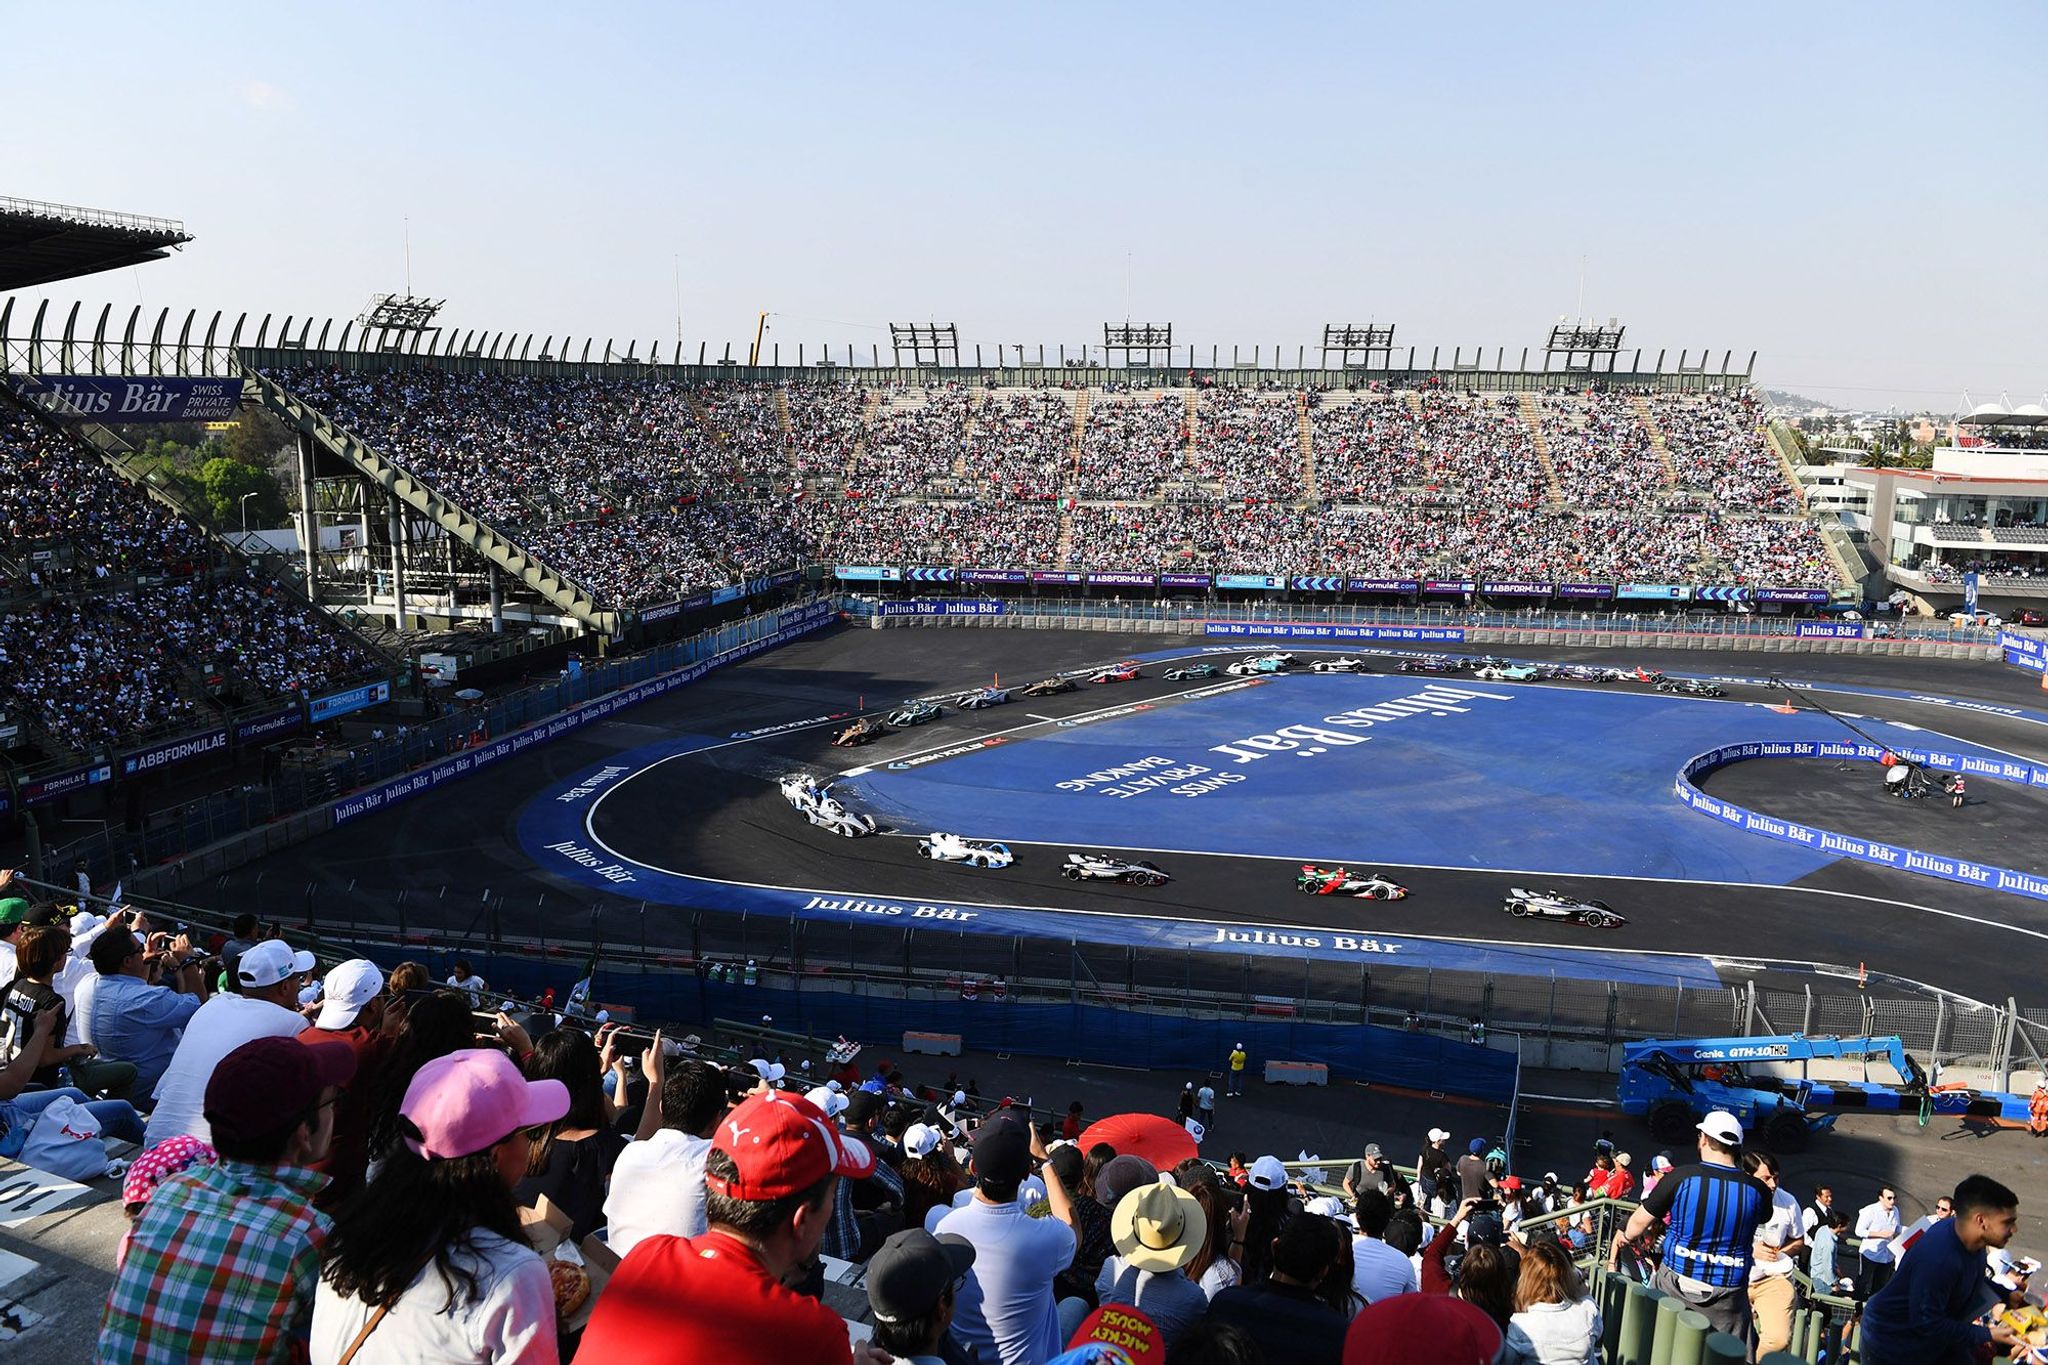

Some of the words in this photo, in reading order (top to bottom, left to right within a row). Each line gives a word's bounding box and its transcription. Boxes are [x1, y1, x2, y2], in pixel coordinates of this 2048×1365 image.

[118, 384, 181, 413] Bär
[191, 385, 223, 396] SWISS
[187, 397, 231, 407] PRIVATE
[182, 408, 231, 418] BANKING
[961, 572, 1025, 580] FIAFormulaE.com
[1350, 581, 1417, 589] FIAFormulaE.com
[1757, 590, 1827, 600] FIAFormulaE.com
[883, 604, 914, 615] Julius
[917, 604, 936, 614] Bär
[945, 604, 976, 614] Julius
[979, 604, 998, 614] Bär
[1207, 624, 1229, 634] Julius
[1250, 626, 1272, 634] Julius
[1292, 626, 1314, 636] Julius
[1335, 628, 1358, 636] Julius
[1378, 628, 1401, 638] Julius
[1421, 630, 1444, 639] Julius
[1800, 624, 1834, 637] Julius
[1836, 625, 1858, 636] Bär
[2000, 634, 2023, 650] Julius
[667, 676, 681, 689] Julius
[640, 686, 656, 699] Julius
[612, 697, 628, 711] Julius
[1324, 684, 1515, 729] Julius
[582, 708, 599, 724] Julius
[548, 721, 567, 736] Julius
[568, 716, 578, 728] Bär
[512, 735, 534, 752] Julius
[534, 728, 546, 742] Bär
[1209, 724, 1372, 764] Bär
[474, 750, 496, 767] Julius
[496, 744, 510, 757] Bär
[1722, 748, 1740, 760] Julius
[1742, 745, 1760, 756] Bär
[1760, 744, 1792, 756] Julius
[1794, 743, 1814, 754] Bär
[1820, 743, 1854, 756] Julius
[1858, 745, 1882, 758] Bär
[1930, 754, 1954, 766] Bär
[432, 765, 455, 784] Julius
[456, 758, 472, 772] Bär
[580, 766, 630, 787] Julius
[1056, 756, 1176, 792] BANKING
[1961, 758, 2000, 774] Julius
[2003, 764, 2028, 779] Bär
[385, 784, 412, 802] Julius
[412, 776, 429, 790] Bär
[1100, 764, 1212, 798] PRIVATE
[1170, 772, 1246, 797] SWISS
[556, 787, 595, 802] Bär
[336, 804, 364, 824] Julius
[366, 794, 382, 809] Bär
[1692, 794, 1720, 814] Julius
[1722, 805, 1742, 822] Bär
[1746, 814, 1785, 836] Julius
[1788, 825, 1814, 843] Bär
[1820, 833, 1865, 855] Julius
[1868, 844, 1898, 862] Bär
[544, 840, 603, 868] Julius
[594, 864, 637, 883] Bär
[1904, 852, 1954, 874] Julius
[1957, 864, 1990, 882] Bär
[1998, 872, 2048, 896] Julius
[802, 896, 904, 916] Julius
[910, 906, 979, 922] Bär
[1214, 928, 1321, 948] Julius
[1332, 936, 1402, 954] Bär
[1694, 1049, 1725, 1059] Genie
[1100, 1310, 1151, 1336] MOUSE
[1090, 1327, 1150, 1354] MICKEY
